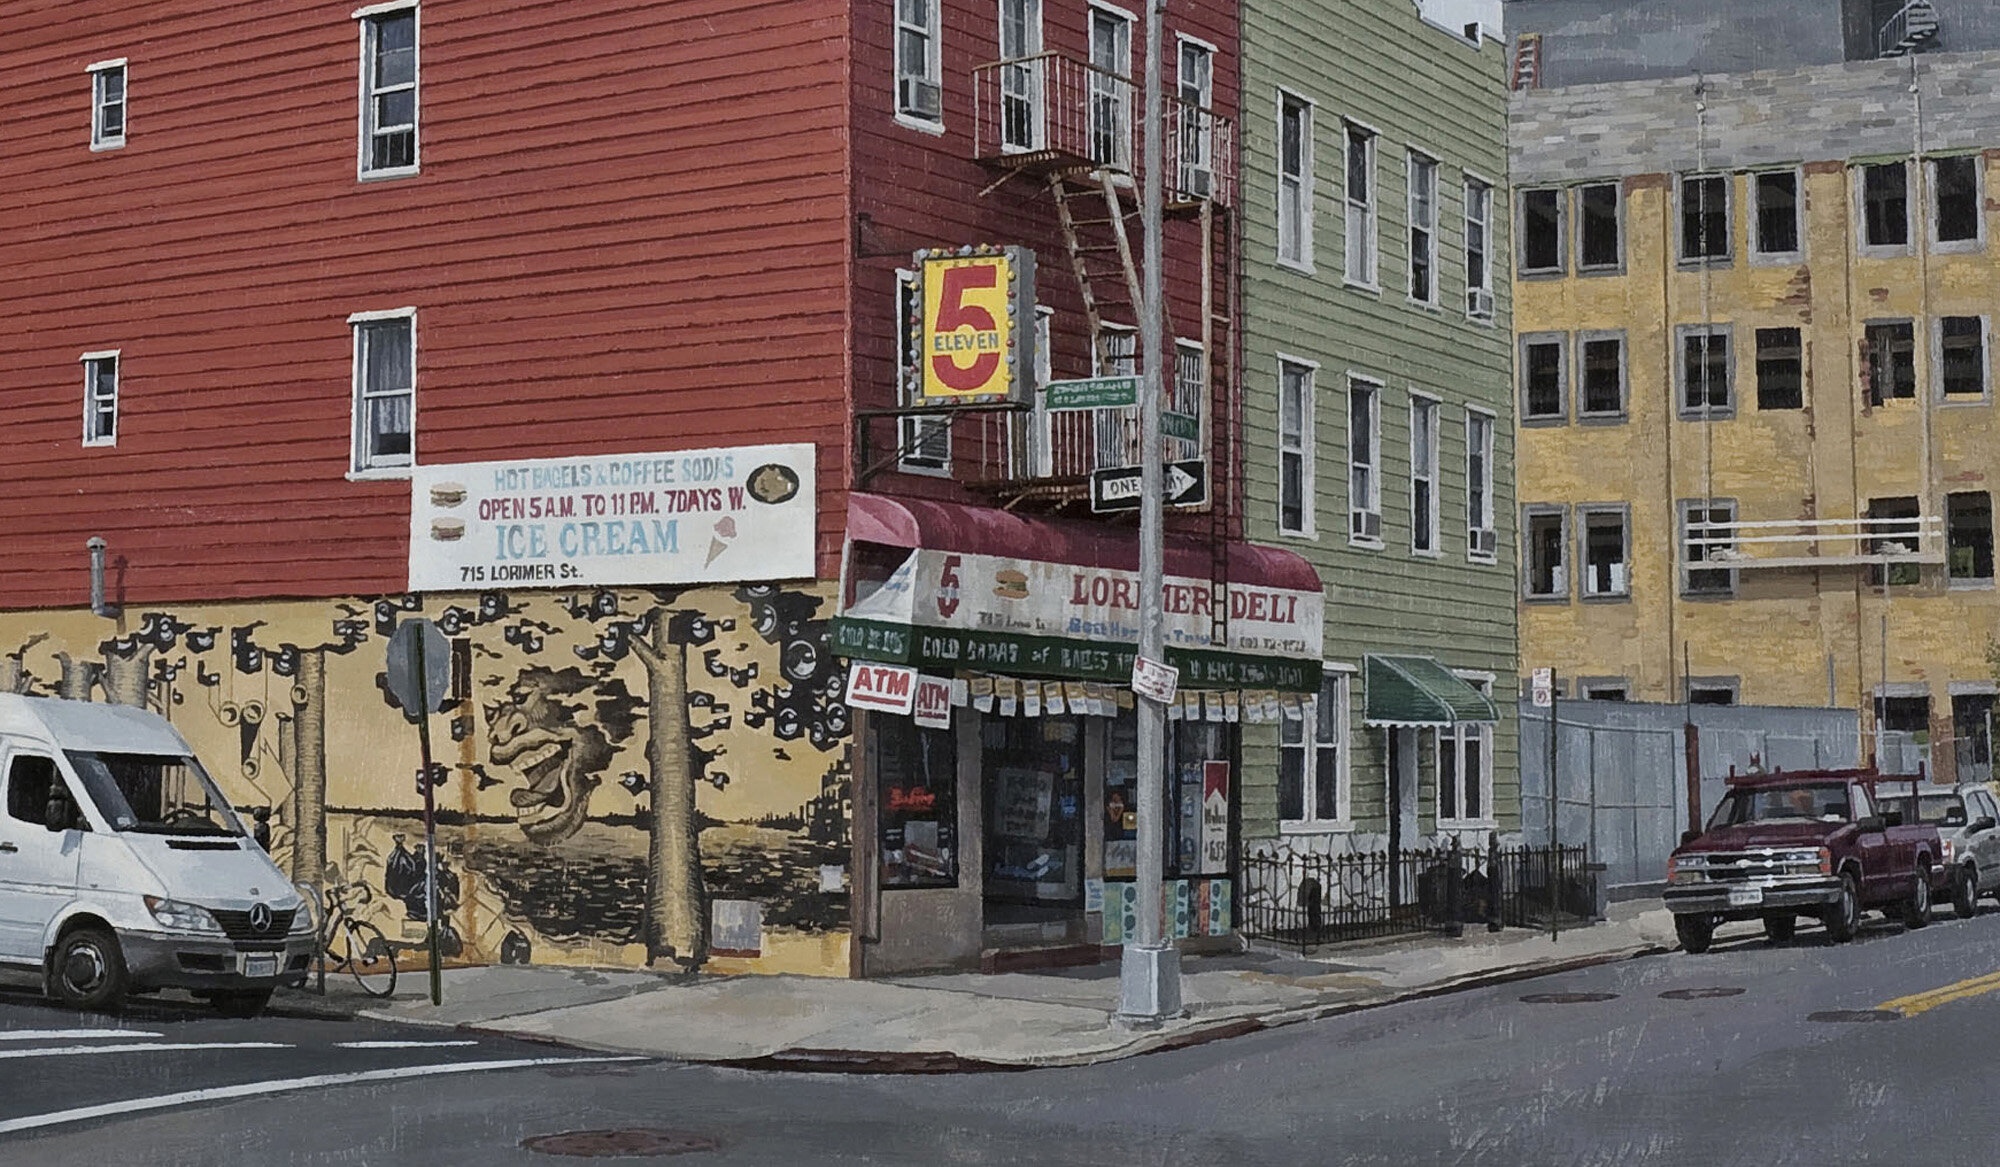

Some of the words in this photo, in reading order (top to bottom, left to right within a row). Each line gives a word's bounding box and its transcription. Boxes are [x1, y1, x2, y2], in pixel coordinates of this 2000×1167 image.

[932, 264, 1000, 391] 5
[934, 333, 999, 351] ELEVEN
[479, 498, 525, 520] OPEN
[582, 494, 606, 517] TO
[611, 493, 625, 515] 11
[728, 486, 746, 511] W.
[1110, 479, 1140, 496] ONE
[496, 523, 548, 560] ICE
[560, 519, 679, 558] CREAM
[460, 566, 485, 582] 715
[491, 564, 555, 581] LORIMER
[560, 563, 583, 579] St.
[1230, 590, 1298, 624] DELI
[853, 666, 910, 697] ATM
[917, 682, 950, 712] ATM
